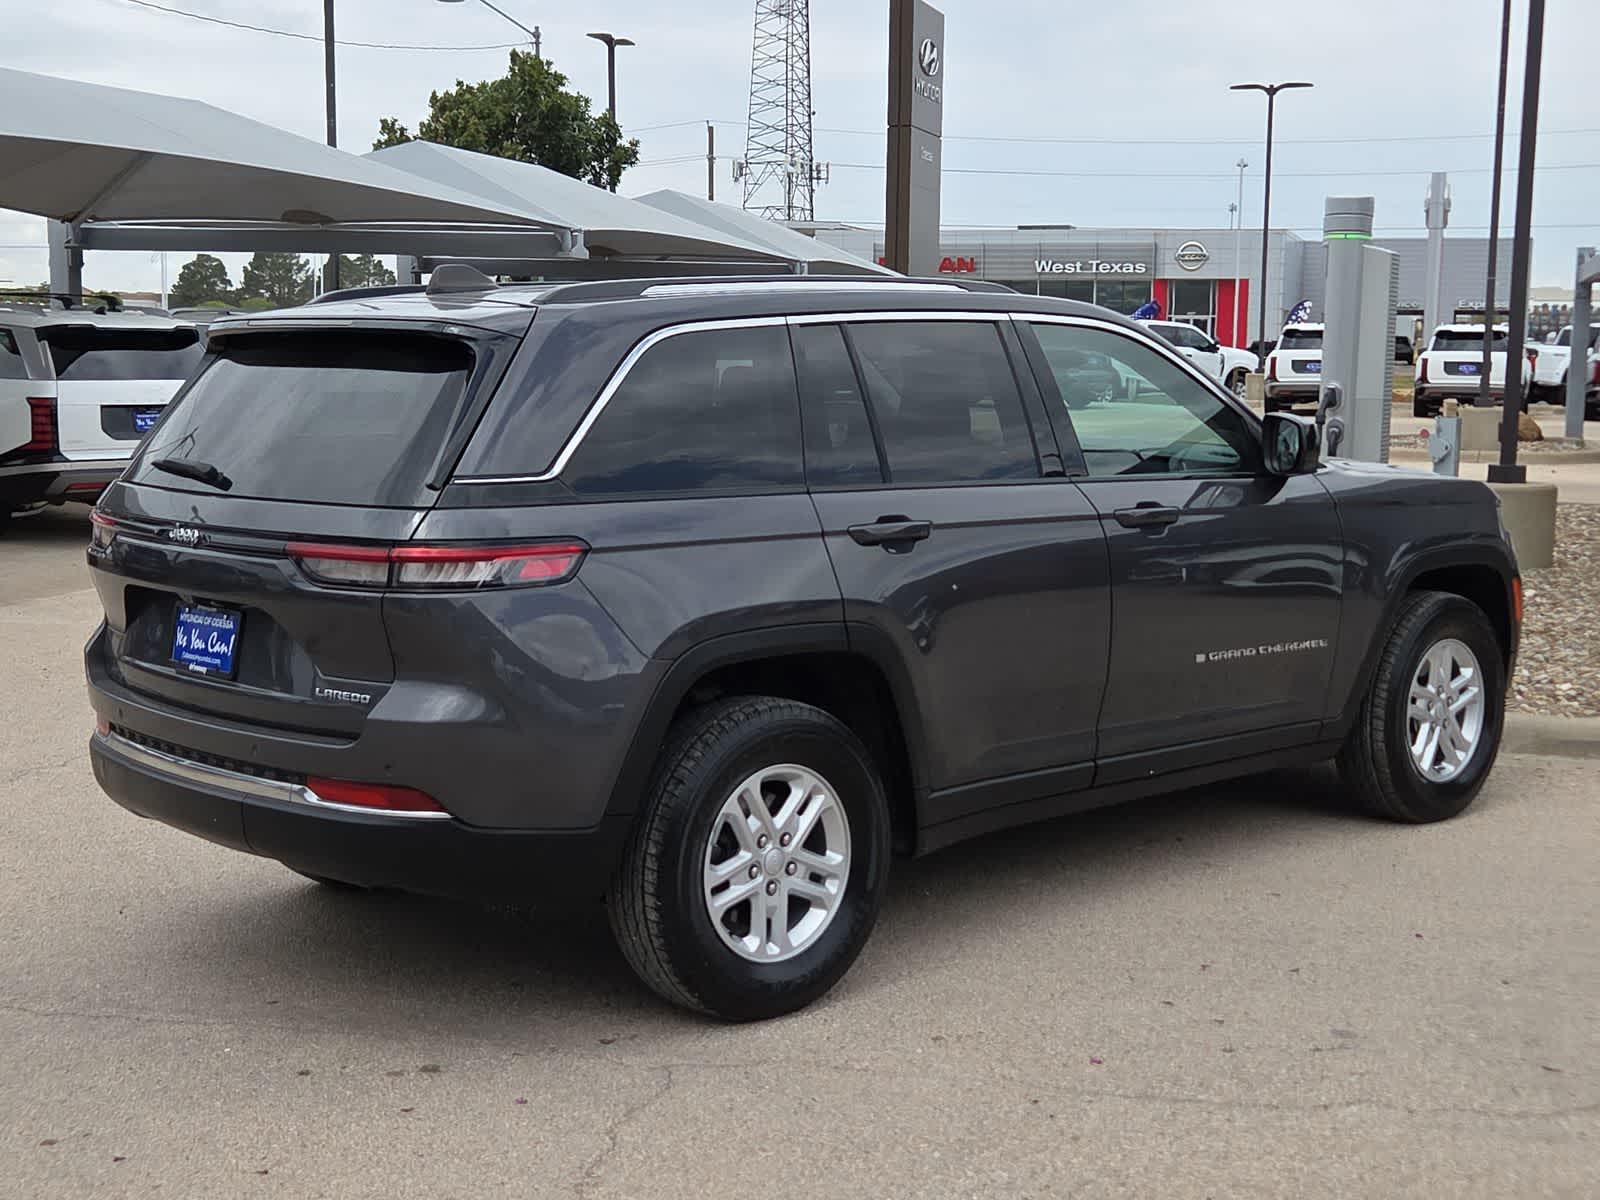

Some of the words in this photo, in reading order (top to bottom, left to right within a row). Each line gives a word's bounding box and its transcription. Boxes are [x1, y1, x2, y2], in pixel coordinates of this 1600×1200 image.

[1034, 260, 1082, 273] West
[1088, 260, 1147, 273] Texas
[176, 626, 187, 648] Yes
[190, 628, 206, 650] You
[1208, 647, 1257, 661] GRAND
[1258, 639, 1328, 655] CHEROKEE
[315, 687, 371, 703] LAREDO
